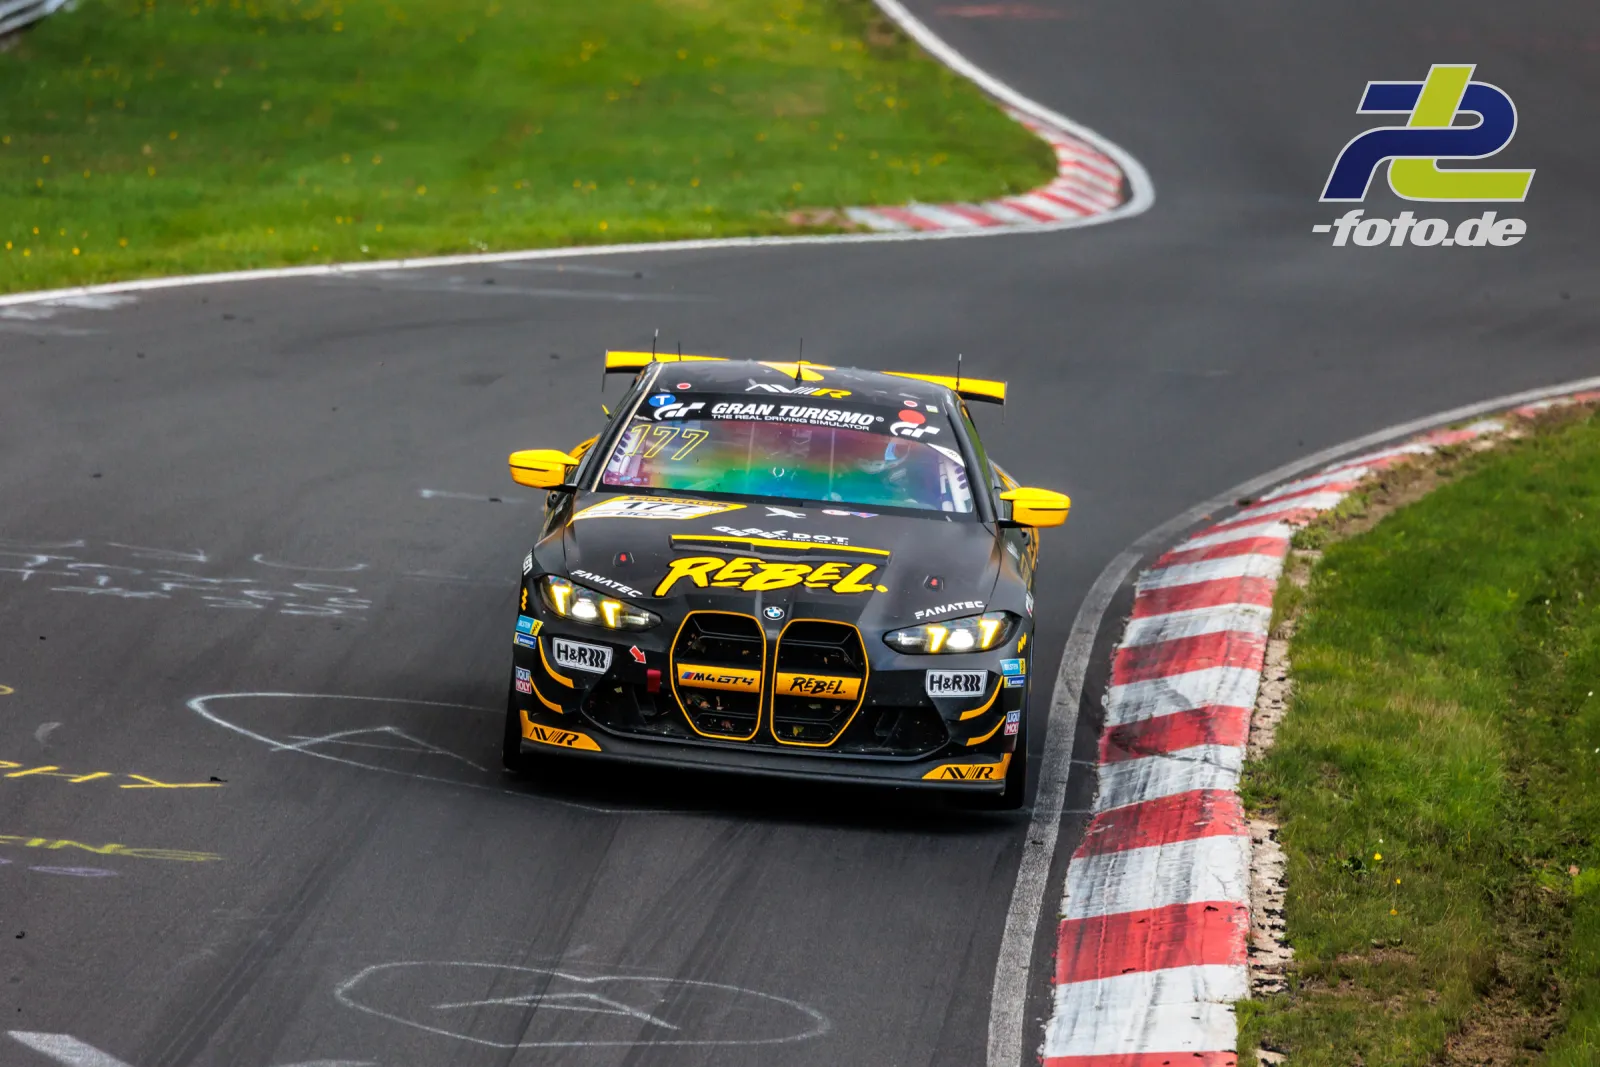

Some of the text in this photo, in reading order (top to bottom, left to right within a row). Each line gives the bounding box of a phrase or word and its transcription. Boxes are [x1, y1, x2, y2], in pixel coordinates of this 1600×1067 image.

[711, 402, 774, 416] GRAN
[764, 415, 807, 424] DRIVING
[809, 419, 870, 431] SIMULATOR
[625, 424, 709, 460] 177
[623, 501, 700, 512] 177
[570, 569, 643, 598] FANATEC
[914, 600, 985, 620] FANATEC
